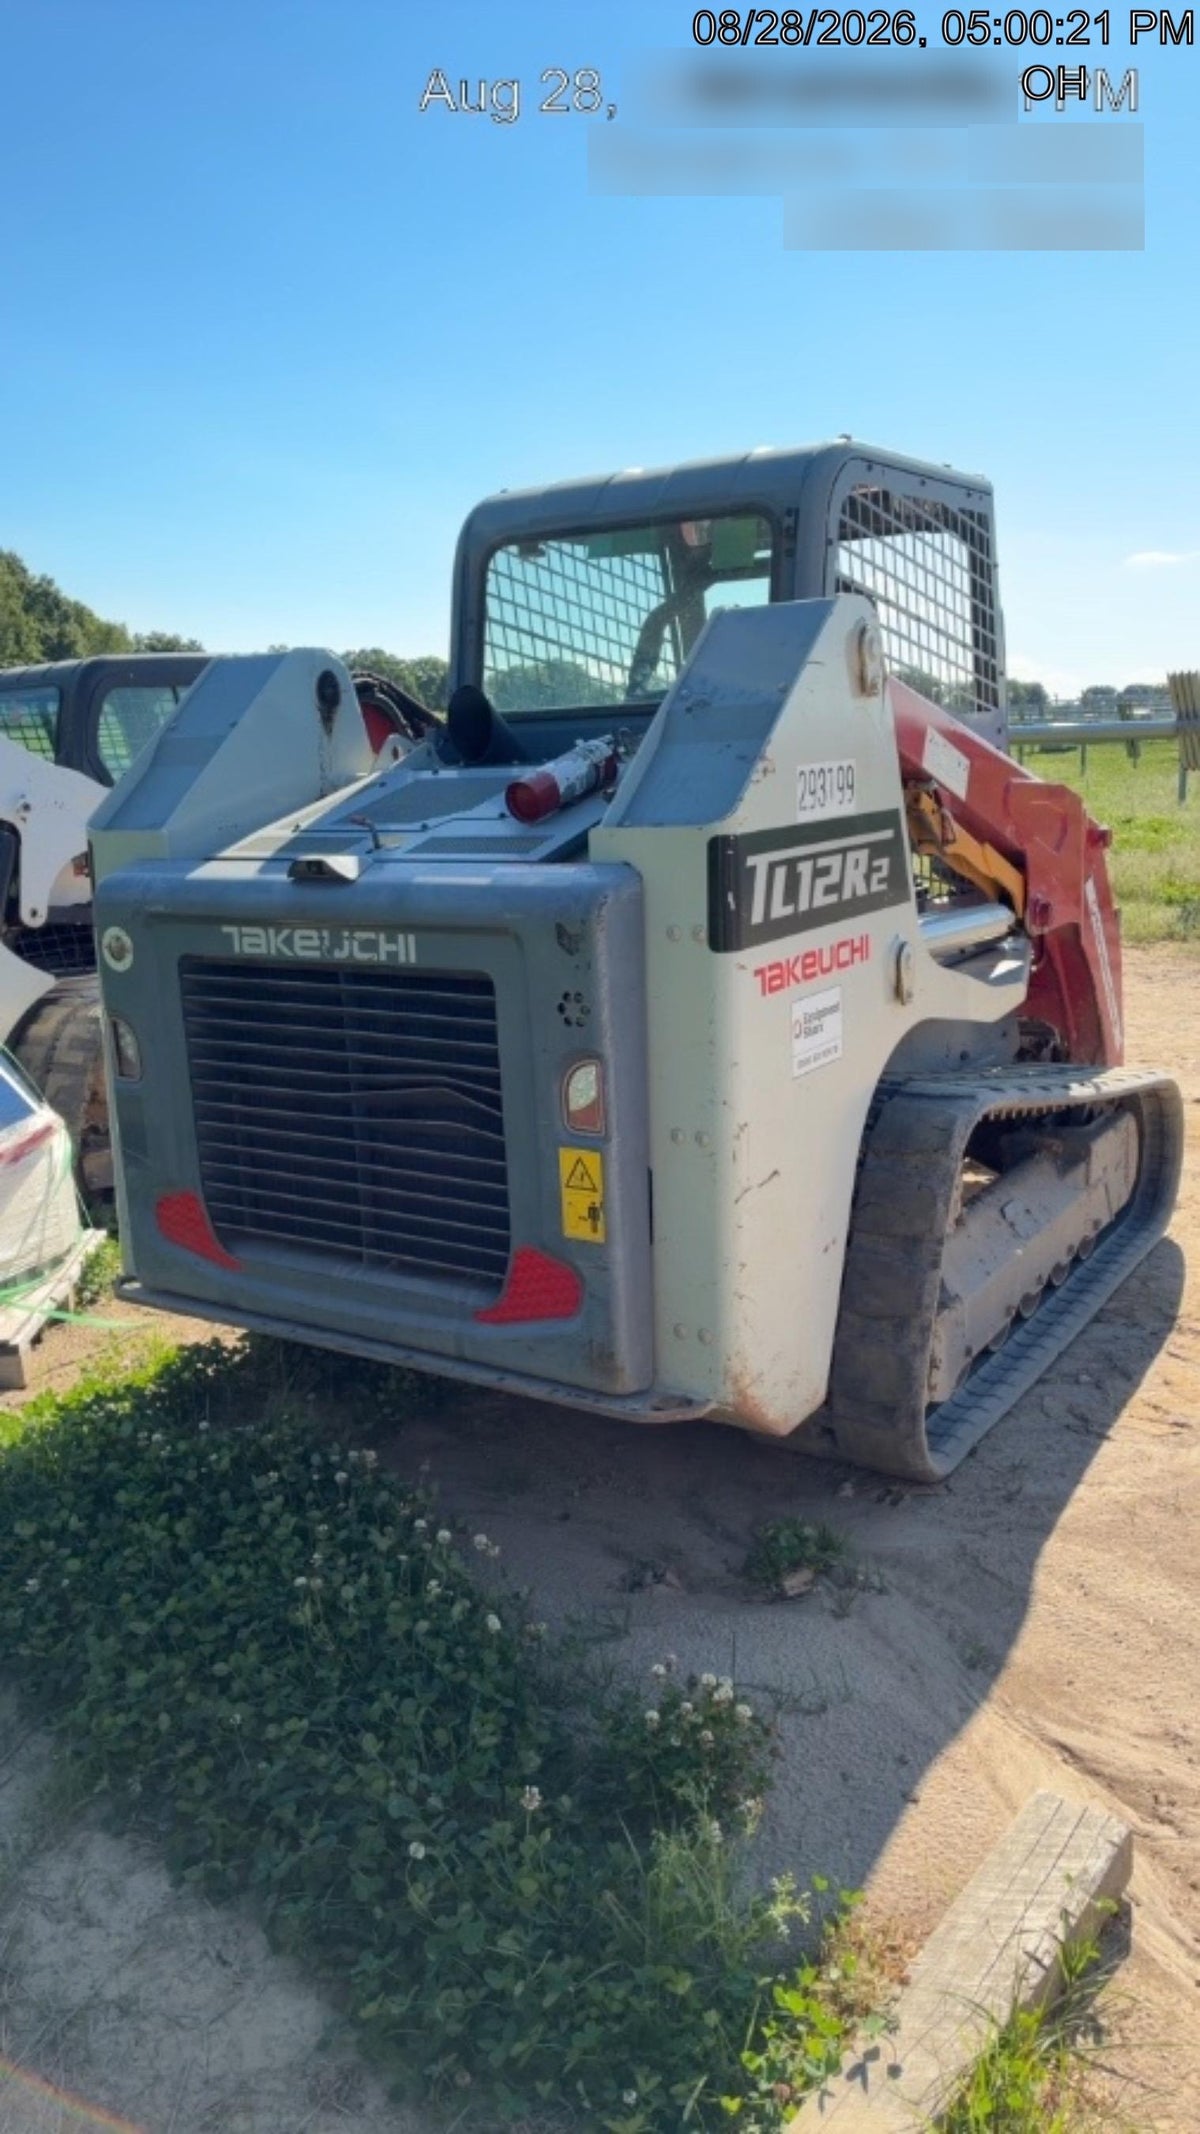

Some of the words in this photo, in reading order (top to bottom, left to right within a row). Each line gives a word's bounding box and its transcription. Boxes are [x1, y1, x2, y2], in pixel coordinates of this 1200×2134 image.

[746, 829, 895, 926] TL12R2
[220, 924, 417, 964] TAKEUCHI
[753, 933, 873, 997] TAKEUCHI
